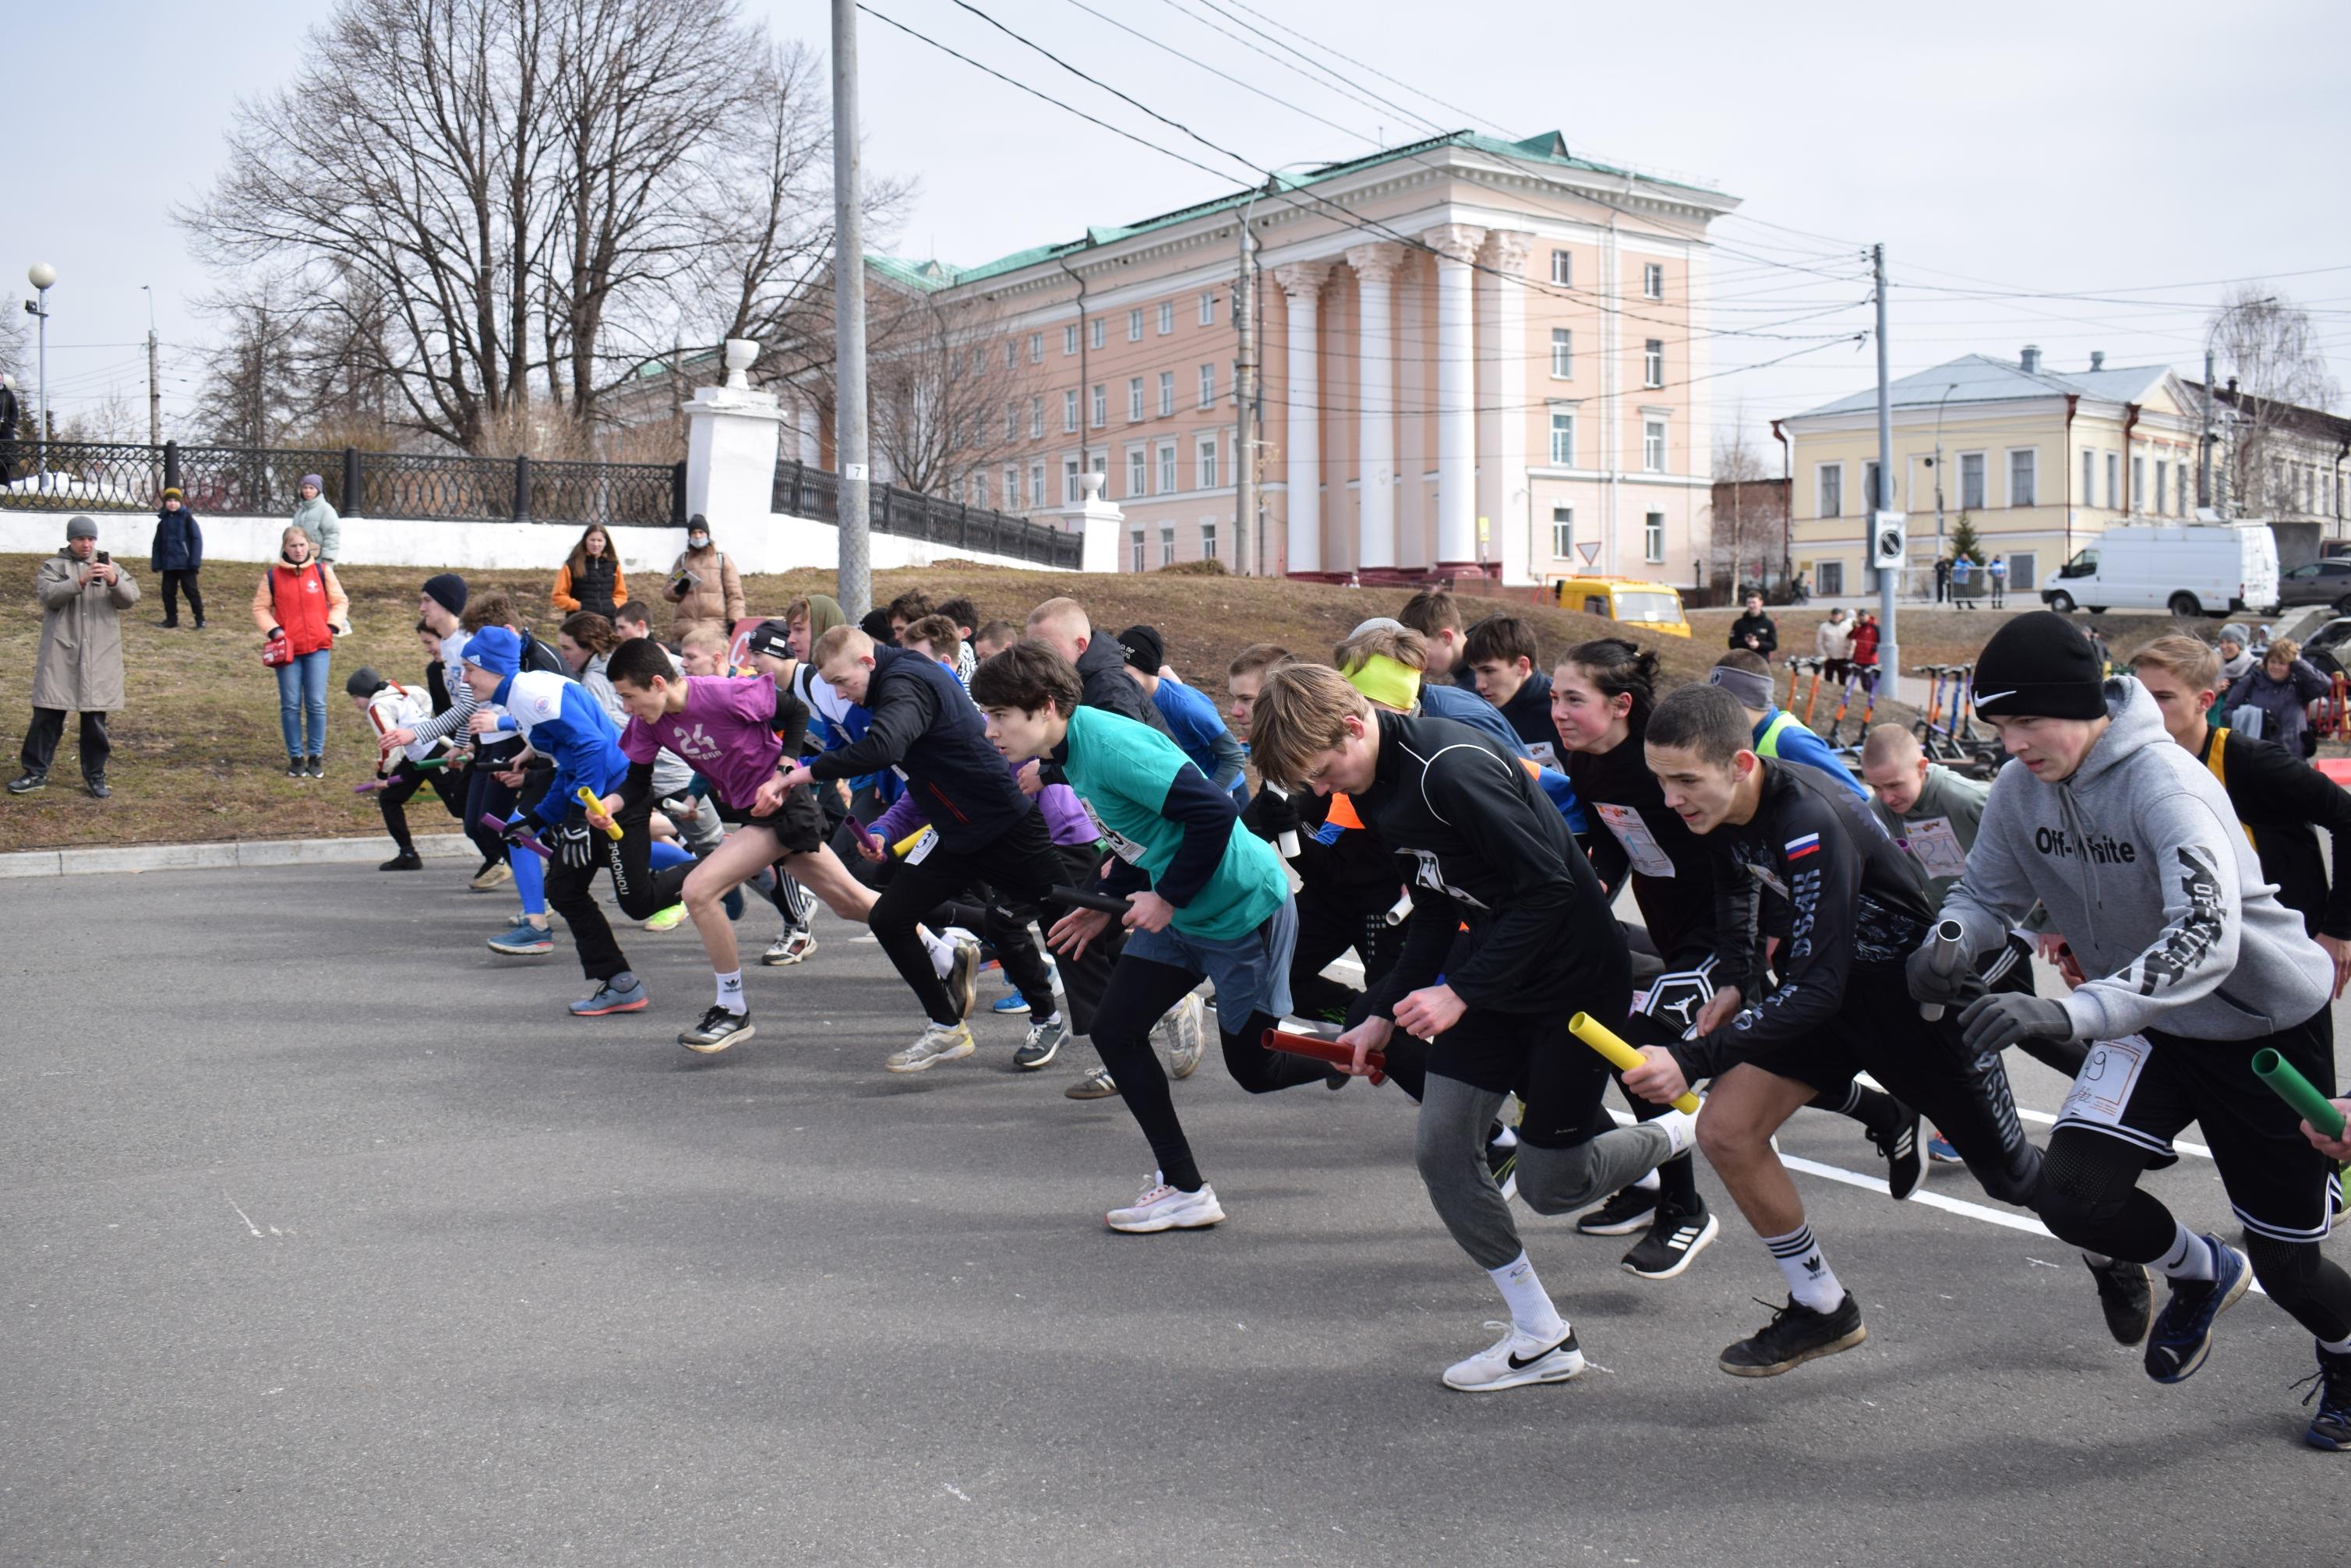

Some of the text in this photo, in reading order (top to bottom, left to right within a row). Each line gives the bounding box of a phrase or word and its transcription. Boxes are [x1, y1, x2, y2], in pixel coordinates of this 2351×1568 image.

[854, 467, 861, 478] 7
[673, 723, 717, 754] 24
[916, 833, 932, 848] 3
[608, 842, 630, 895] ПОМОРЬЕ
